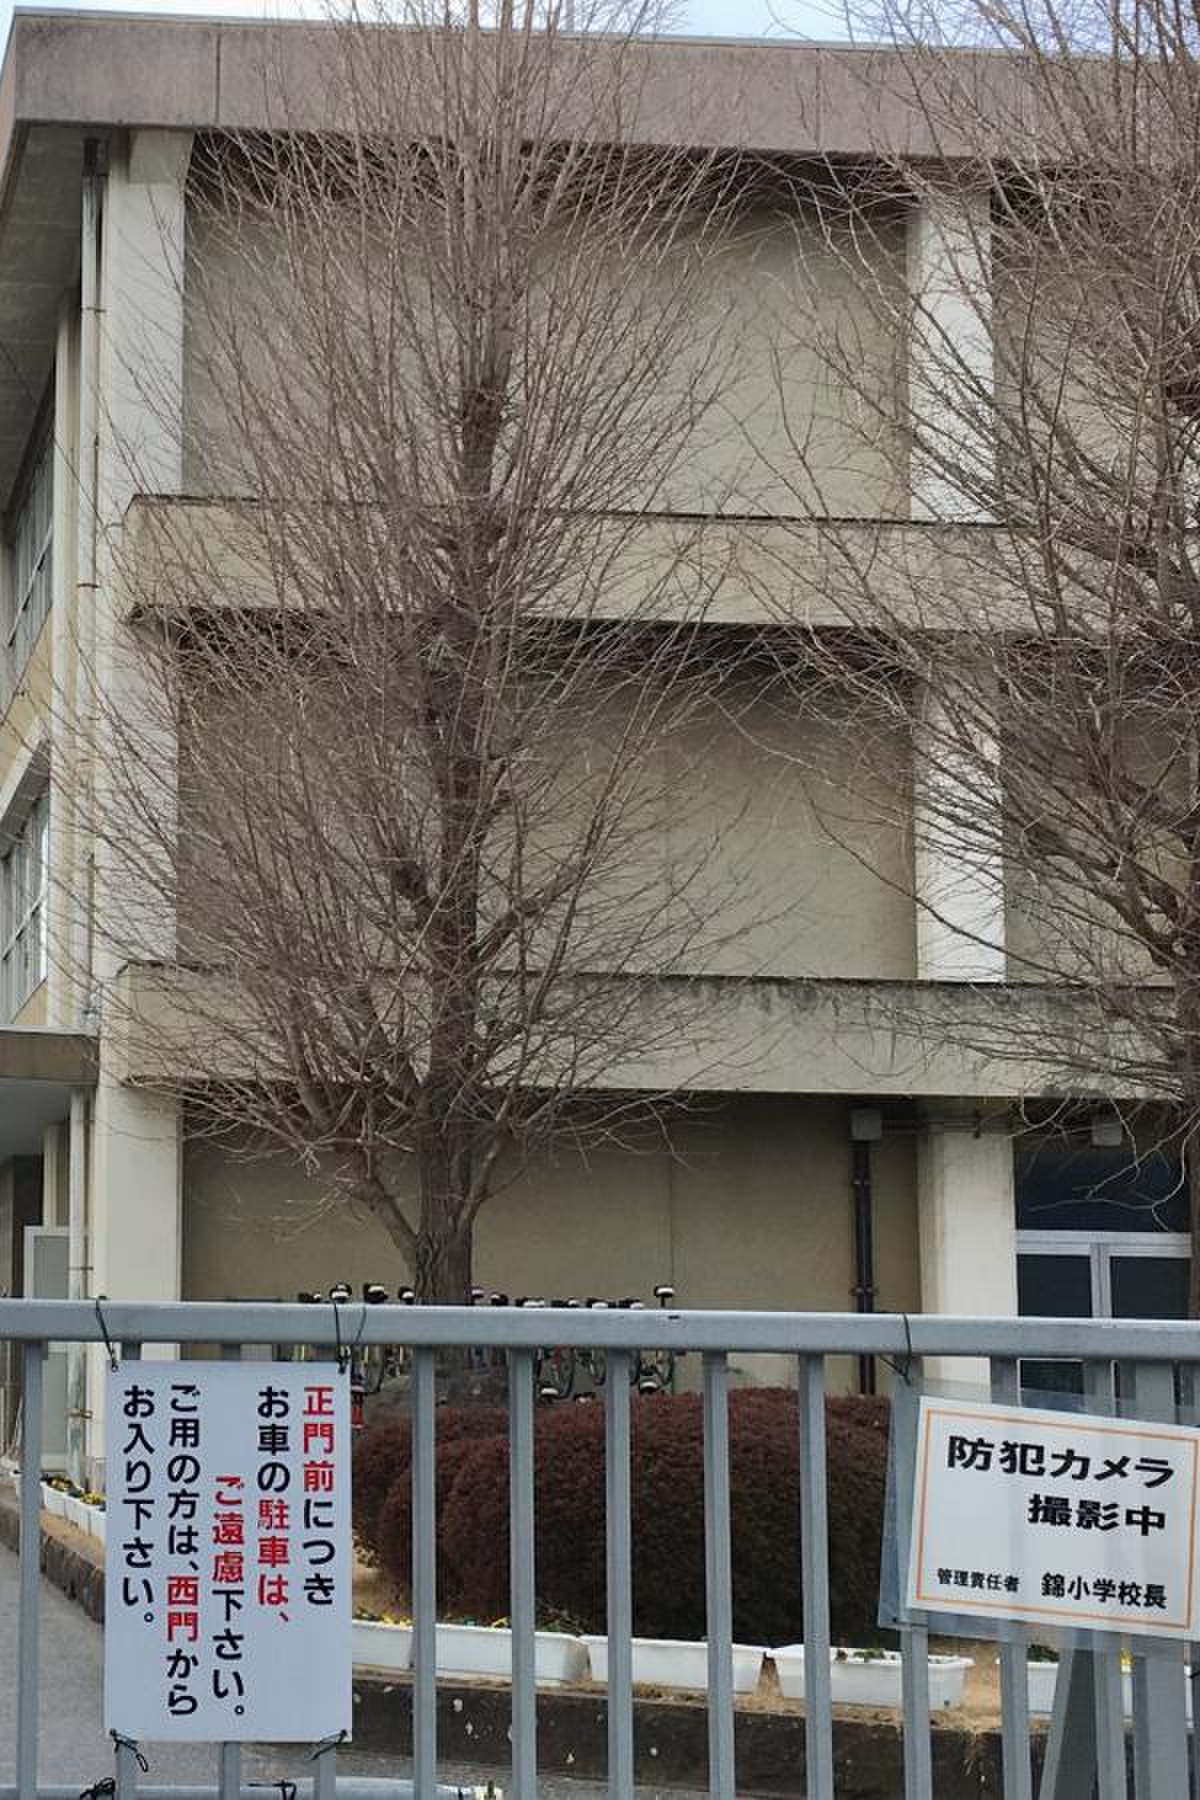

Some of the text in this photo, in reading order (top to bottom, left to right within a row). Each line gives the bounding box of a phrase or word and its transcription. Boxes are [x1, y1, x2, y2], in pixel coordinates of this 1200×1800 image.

[122, 1385, 155, 1623] お入り下さい。
[166, 1385, 200, 1716] ご用の方は、西門から
[256, 1386, 290, 1622] お車の駐車は、
[302, 1386, 335, 1606] 正門前につき
[947, 1436, 1175, 1488] 防犯カメラ
[1028, 1494, 1166, 1536] 撮影中
[212, 1476, 245, 1716] ご遠慮下さい。
[936, 1567, 1168, 1610] 管理責任者 錦小学校長
